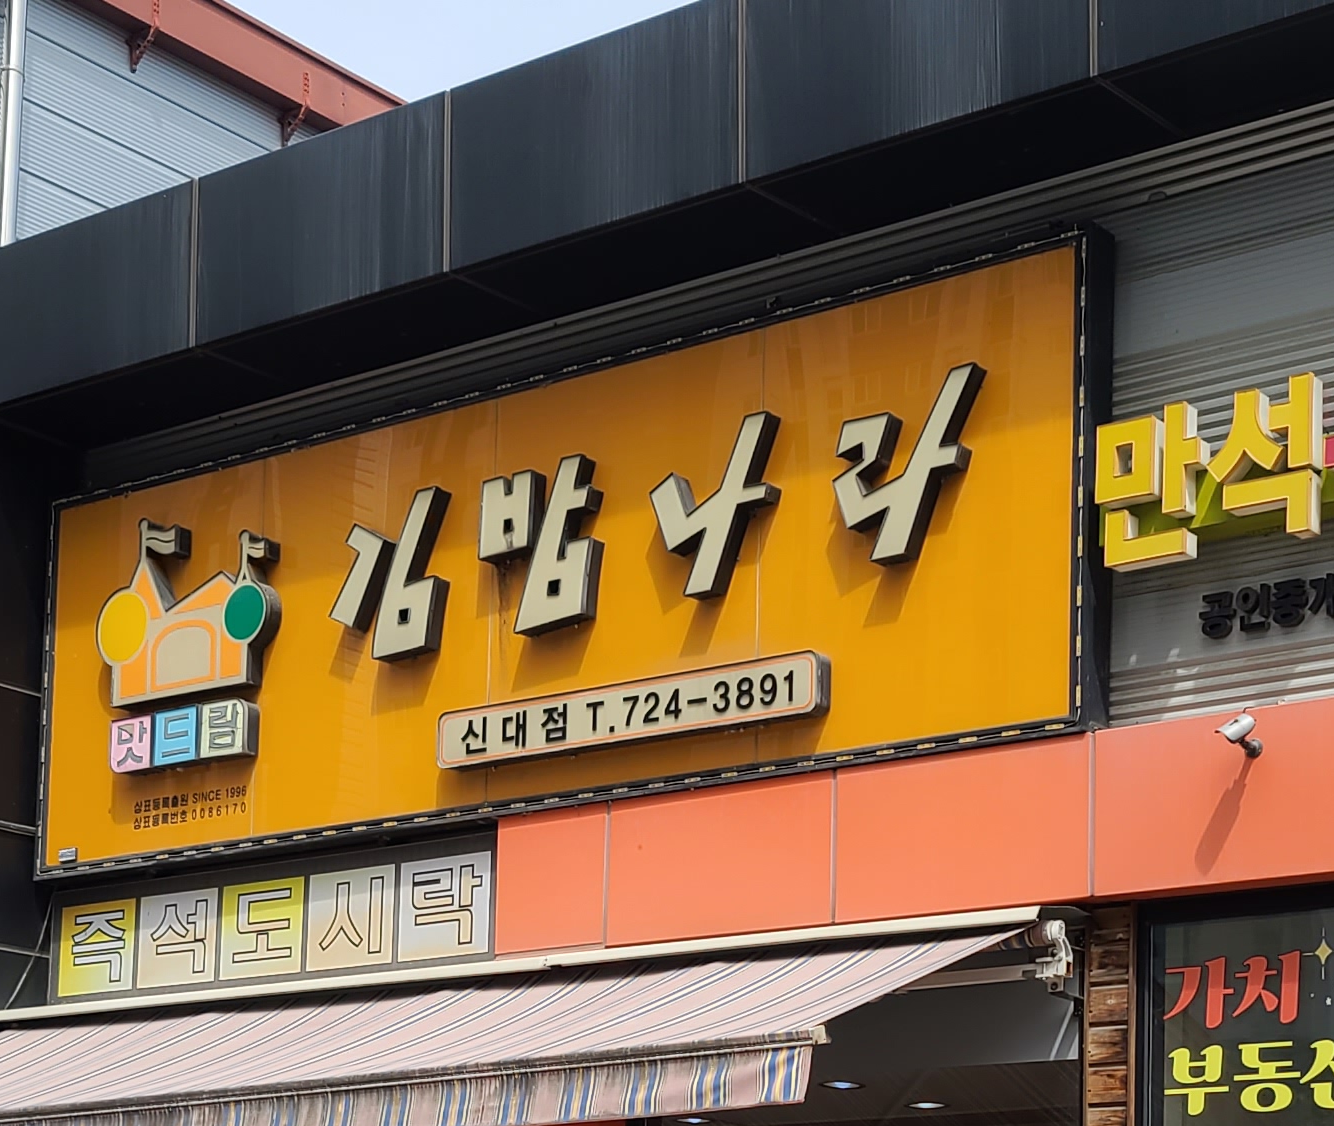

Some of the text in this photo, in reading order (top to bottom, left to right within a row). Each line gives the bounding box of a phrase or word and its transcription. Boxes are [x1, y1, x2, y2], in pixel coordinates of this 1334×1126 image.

[329, 361, 986, 664] 김밥나라
[116, 702, 239, 768] 맛드림
[460, 702, 568, 754] 신대점
[133, 810, 188, 830] 상표등록번호
[192, 788, 222, 804] SINCE
[71, 864, 484, 983] 즉석도시락
[1163, 949, 1301, 1030] 가치
